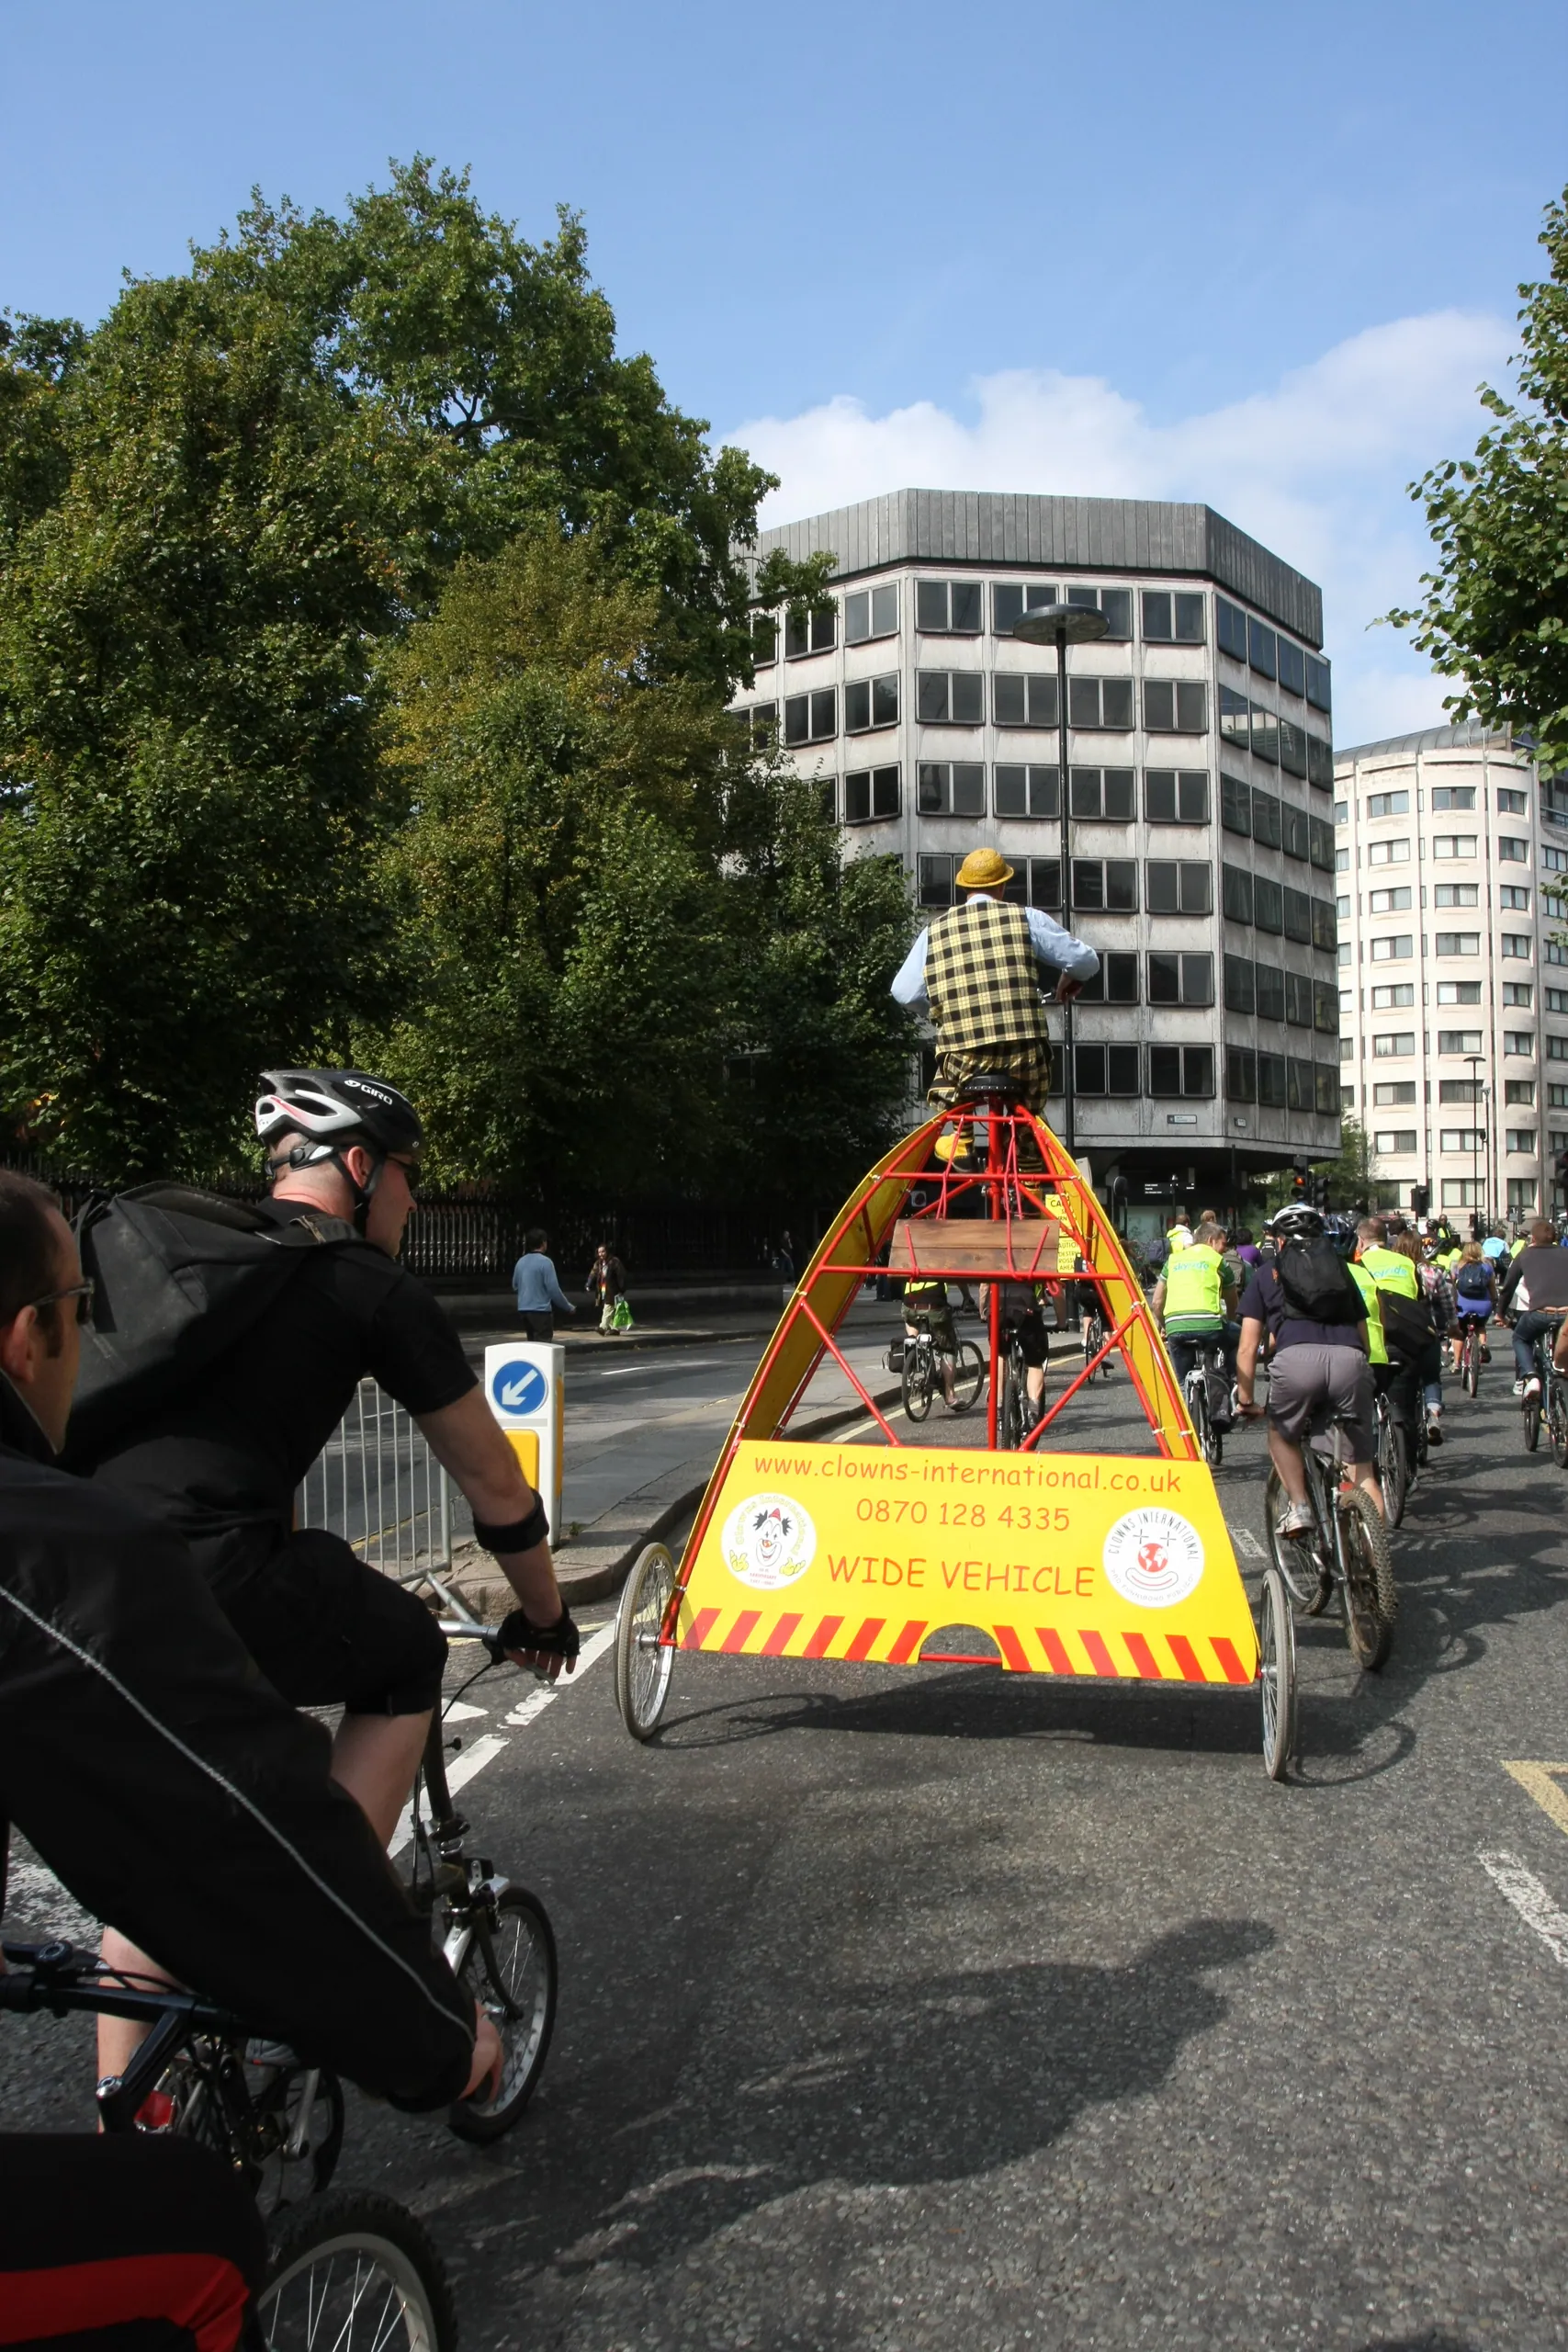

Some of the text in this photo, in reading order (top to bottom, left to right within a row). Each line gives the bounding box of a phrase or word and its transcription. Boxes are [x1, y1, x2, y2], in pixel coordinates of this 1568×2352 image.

[360, 1084, 393, 1105] GIRO
[755, 1454, 1180, 1492] www.clowns-international.co.uk
[856, 1498, 1070, 1532] 0870 128 4335
[1108, 1511, 1200, 1560] CLOWNS INTERNATIONAL
[828, 1555, 1096, 1598] WIDE VEHICLE
